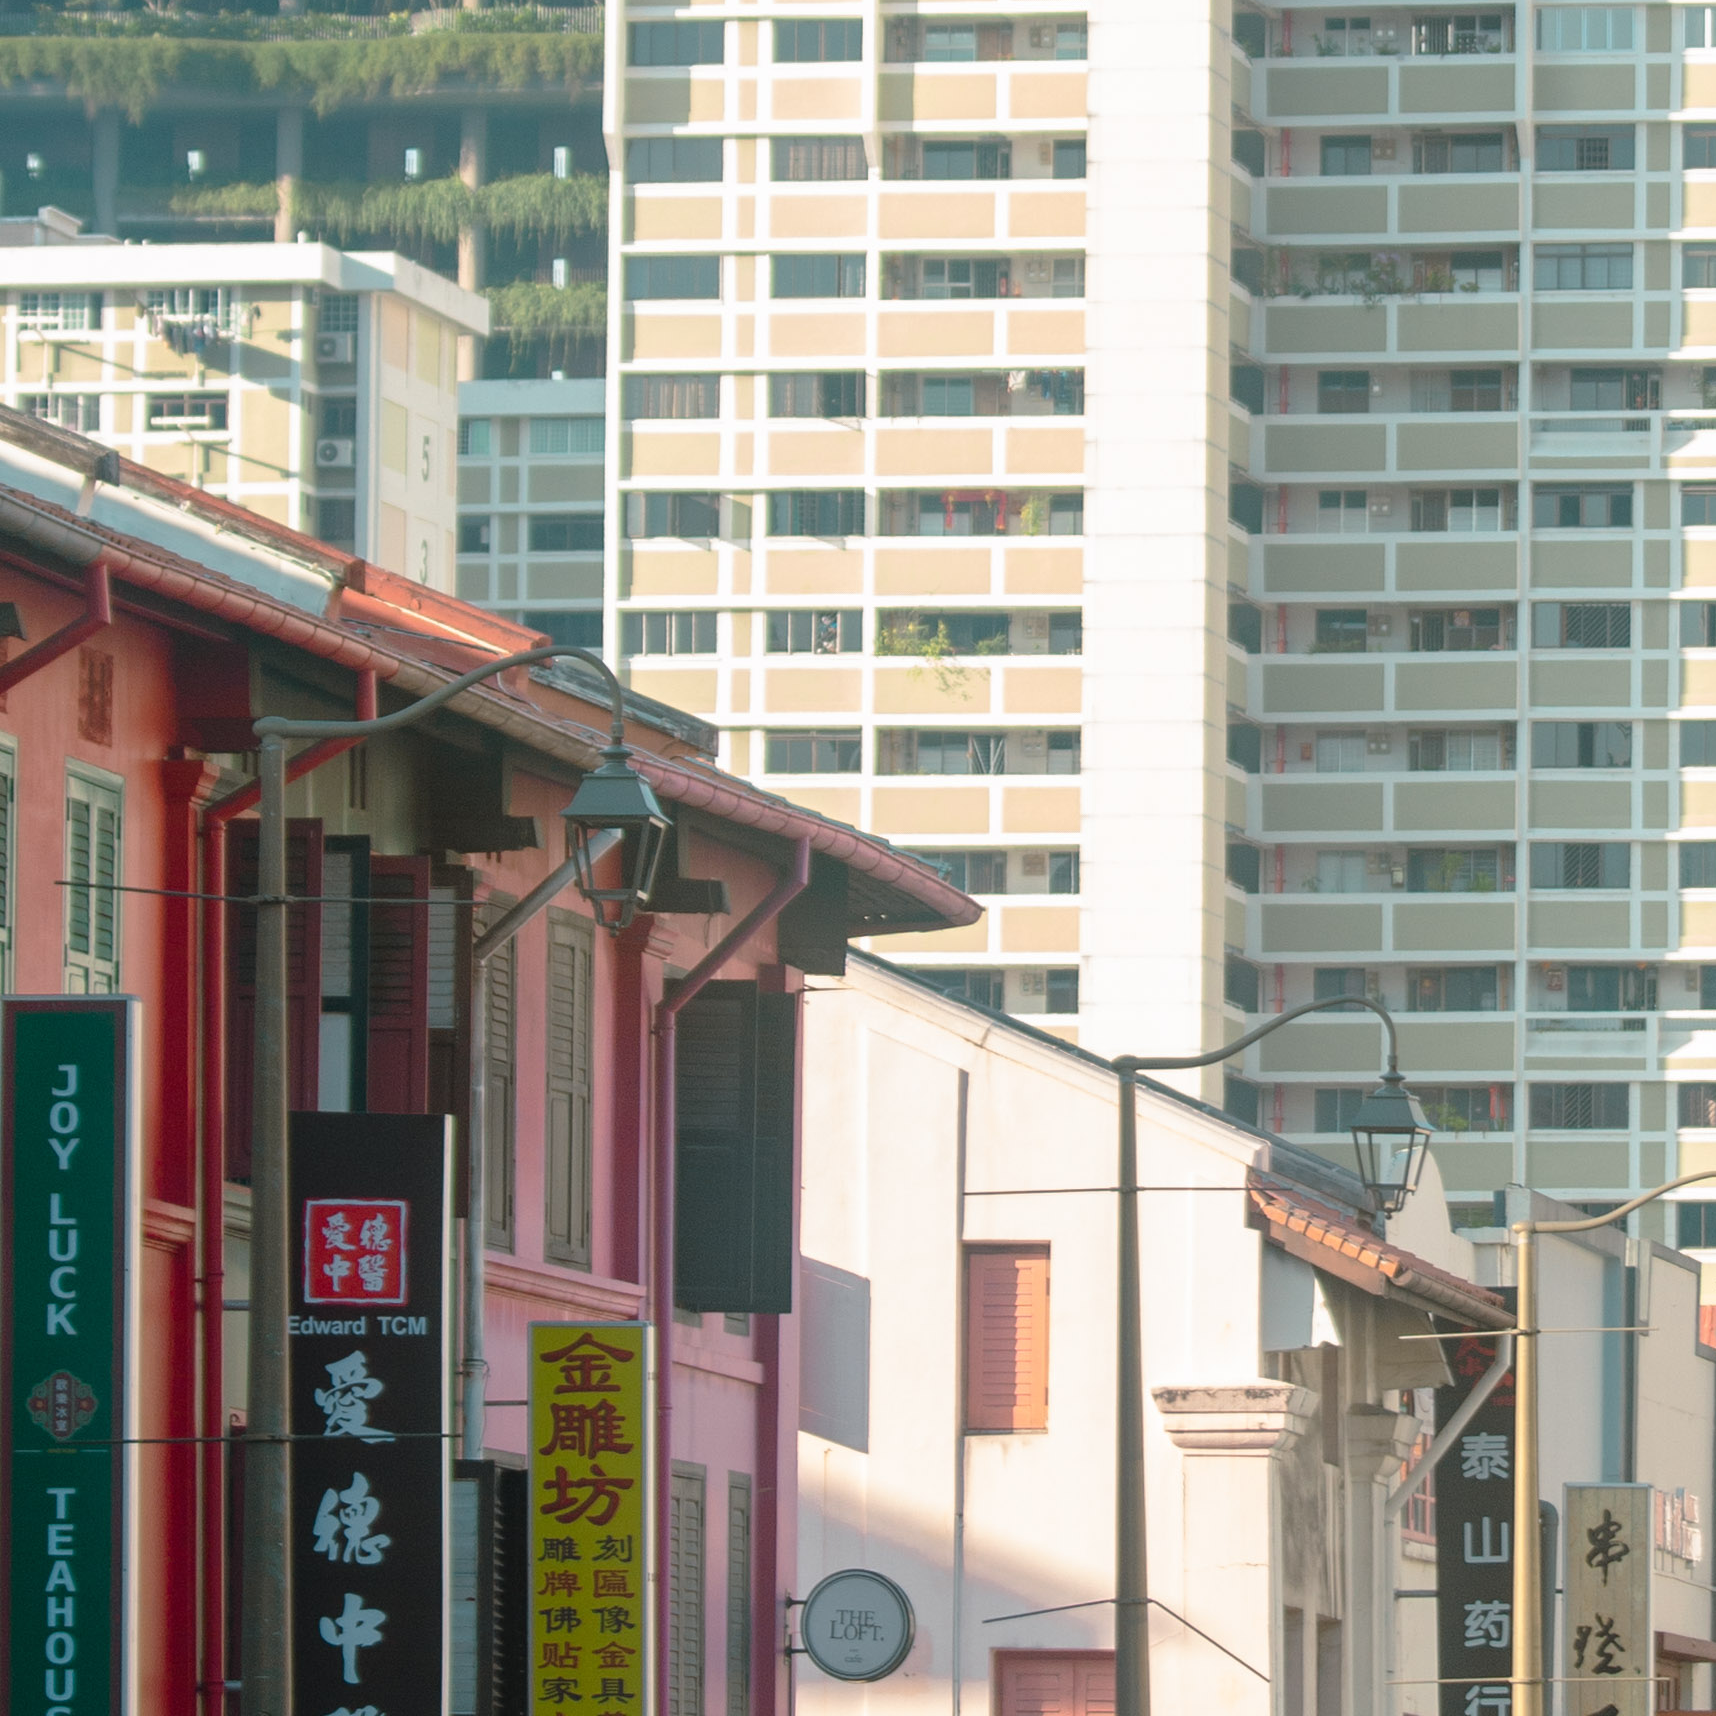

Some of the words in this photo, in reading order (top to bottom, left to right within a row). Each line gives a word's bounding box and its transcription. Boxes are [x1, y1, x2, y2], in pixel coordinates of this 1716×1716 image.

[48, 1064, 80, 1170] JOY
[46, 1193, 78, 1335] LUCK
[288, 1316, 366, 1334] Edward
[377, 1316, 427, 1334] TCM
[539, 1332, 634, 1526] 金雕坊
[538, 1535, 636, 1563] 雕刻
[538, 1569, 636, 1599] 牌匾
[538, 1605, 636, 1634] 佛像
[836, 1609, 875, 1627] THE
[538, 1641, 636, 1668] 贴金
[538, 1676, 636, 1704] 家具
